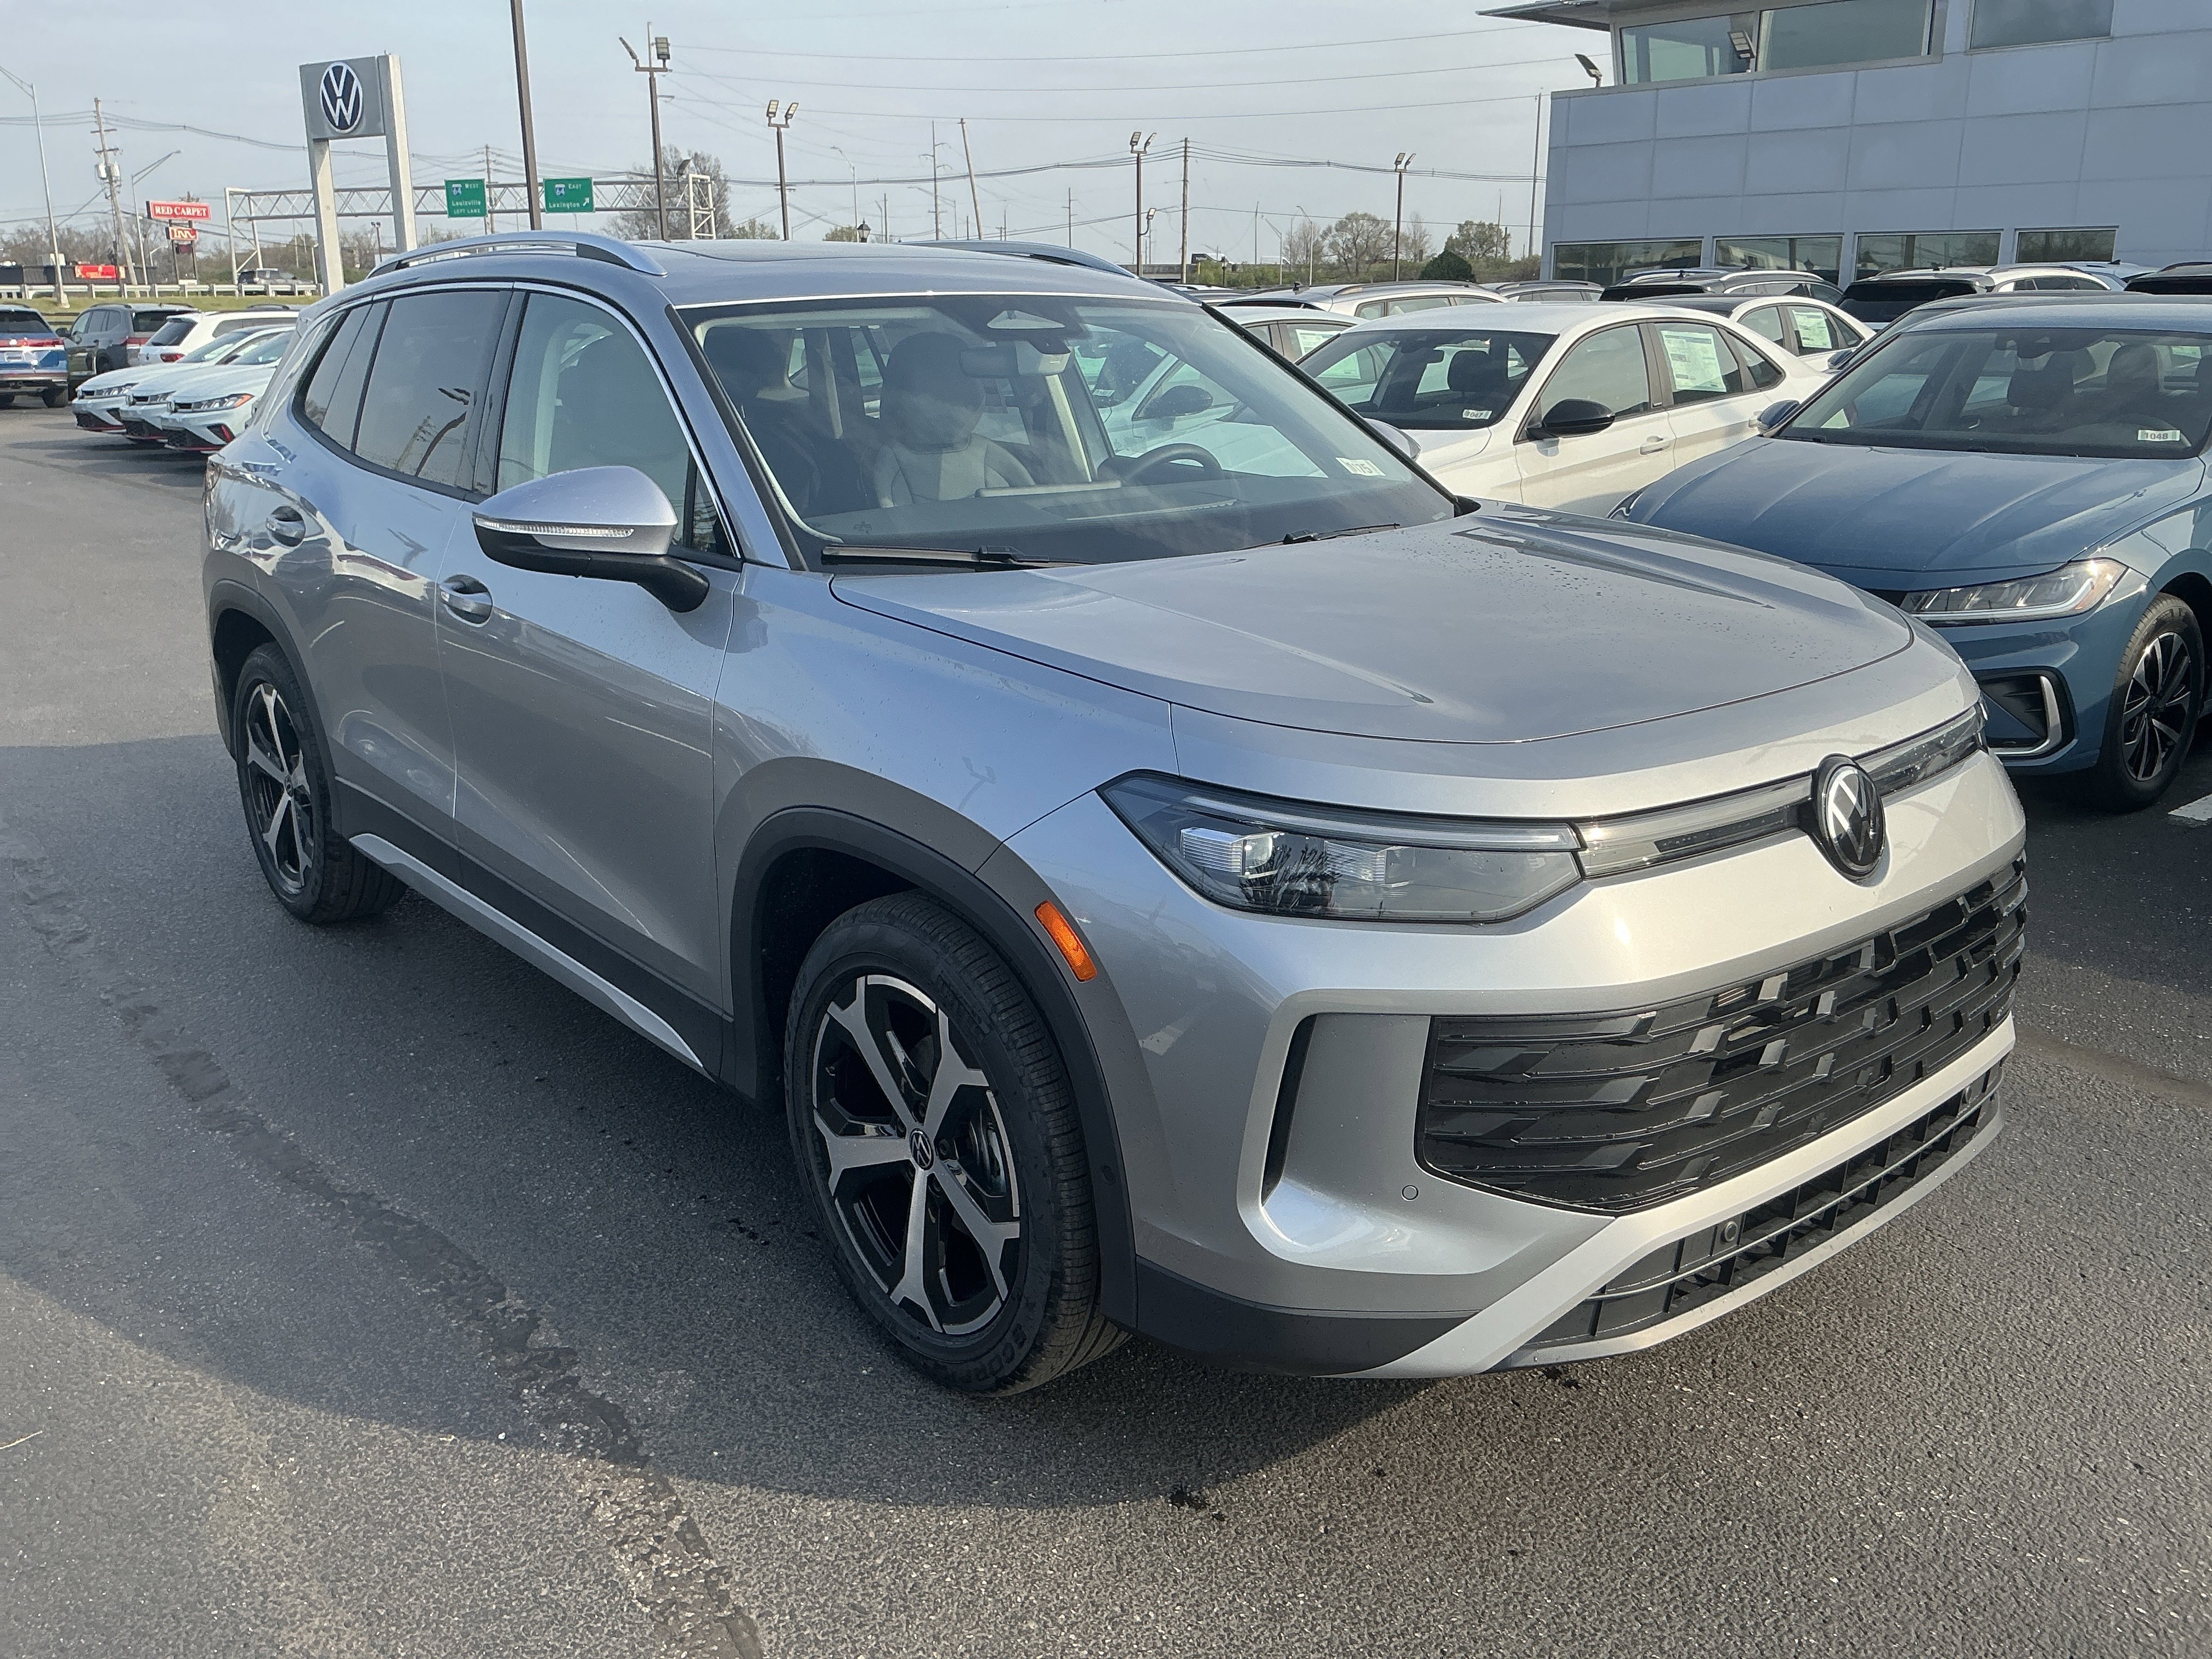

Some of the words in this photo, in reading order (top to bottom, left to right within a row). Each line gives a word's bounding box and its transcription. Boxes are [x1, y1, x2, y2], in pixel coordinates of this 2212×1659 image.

[320, 62, 363, 133] VW
[155, 206, 173, 216] RED
[174, 206, 207, 217] CARPET
[2143, 432, 2169, 440] 1048
